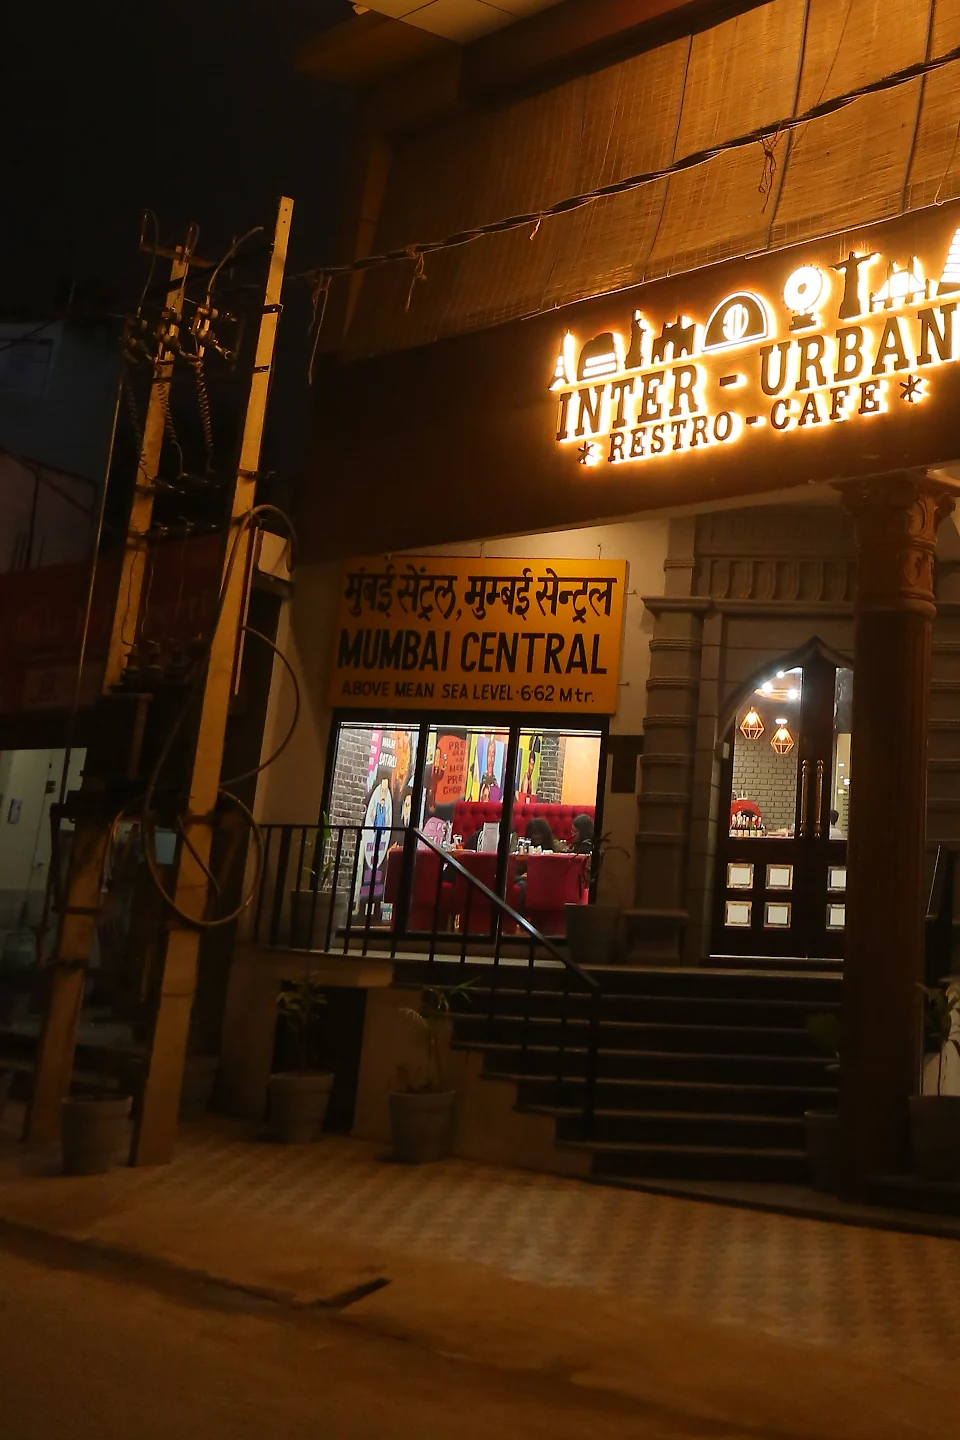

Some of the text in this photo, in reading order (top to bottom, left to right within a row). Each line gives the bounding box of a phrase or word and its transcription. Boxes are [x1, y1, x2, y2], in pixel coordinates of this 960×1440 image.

[555, 363, 699, 442] INTER
[759, 303, 958, 397] URBAN
[607, 410, 734, 463] RESTRO
[770, 379, 881, 430] CAFE
[337, 627, 607, 675] MUMBAI CENTRAL
[341, 681, 390, 697] ABOVE
[394, 682, 435, 699] MEAN
[442, 683, 469, 700] SEA
